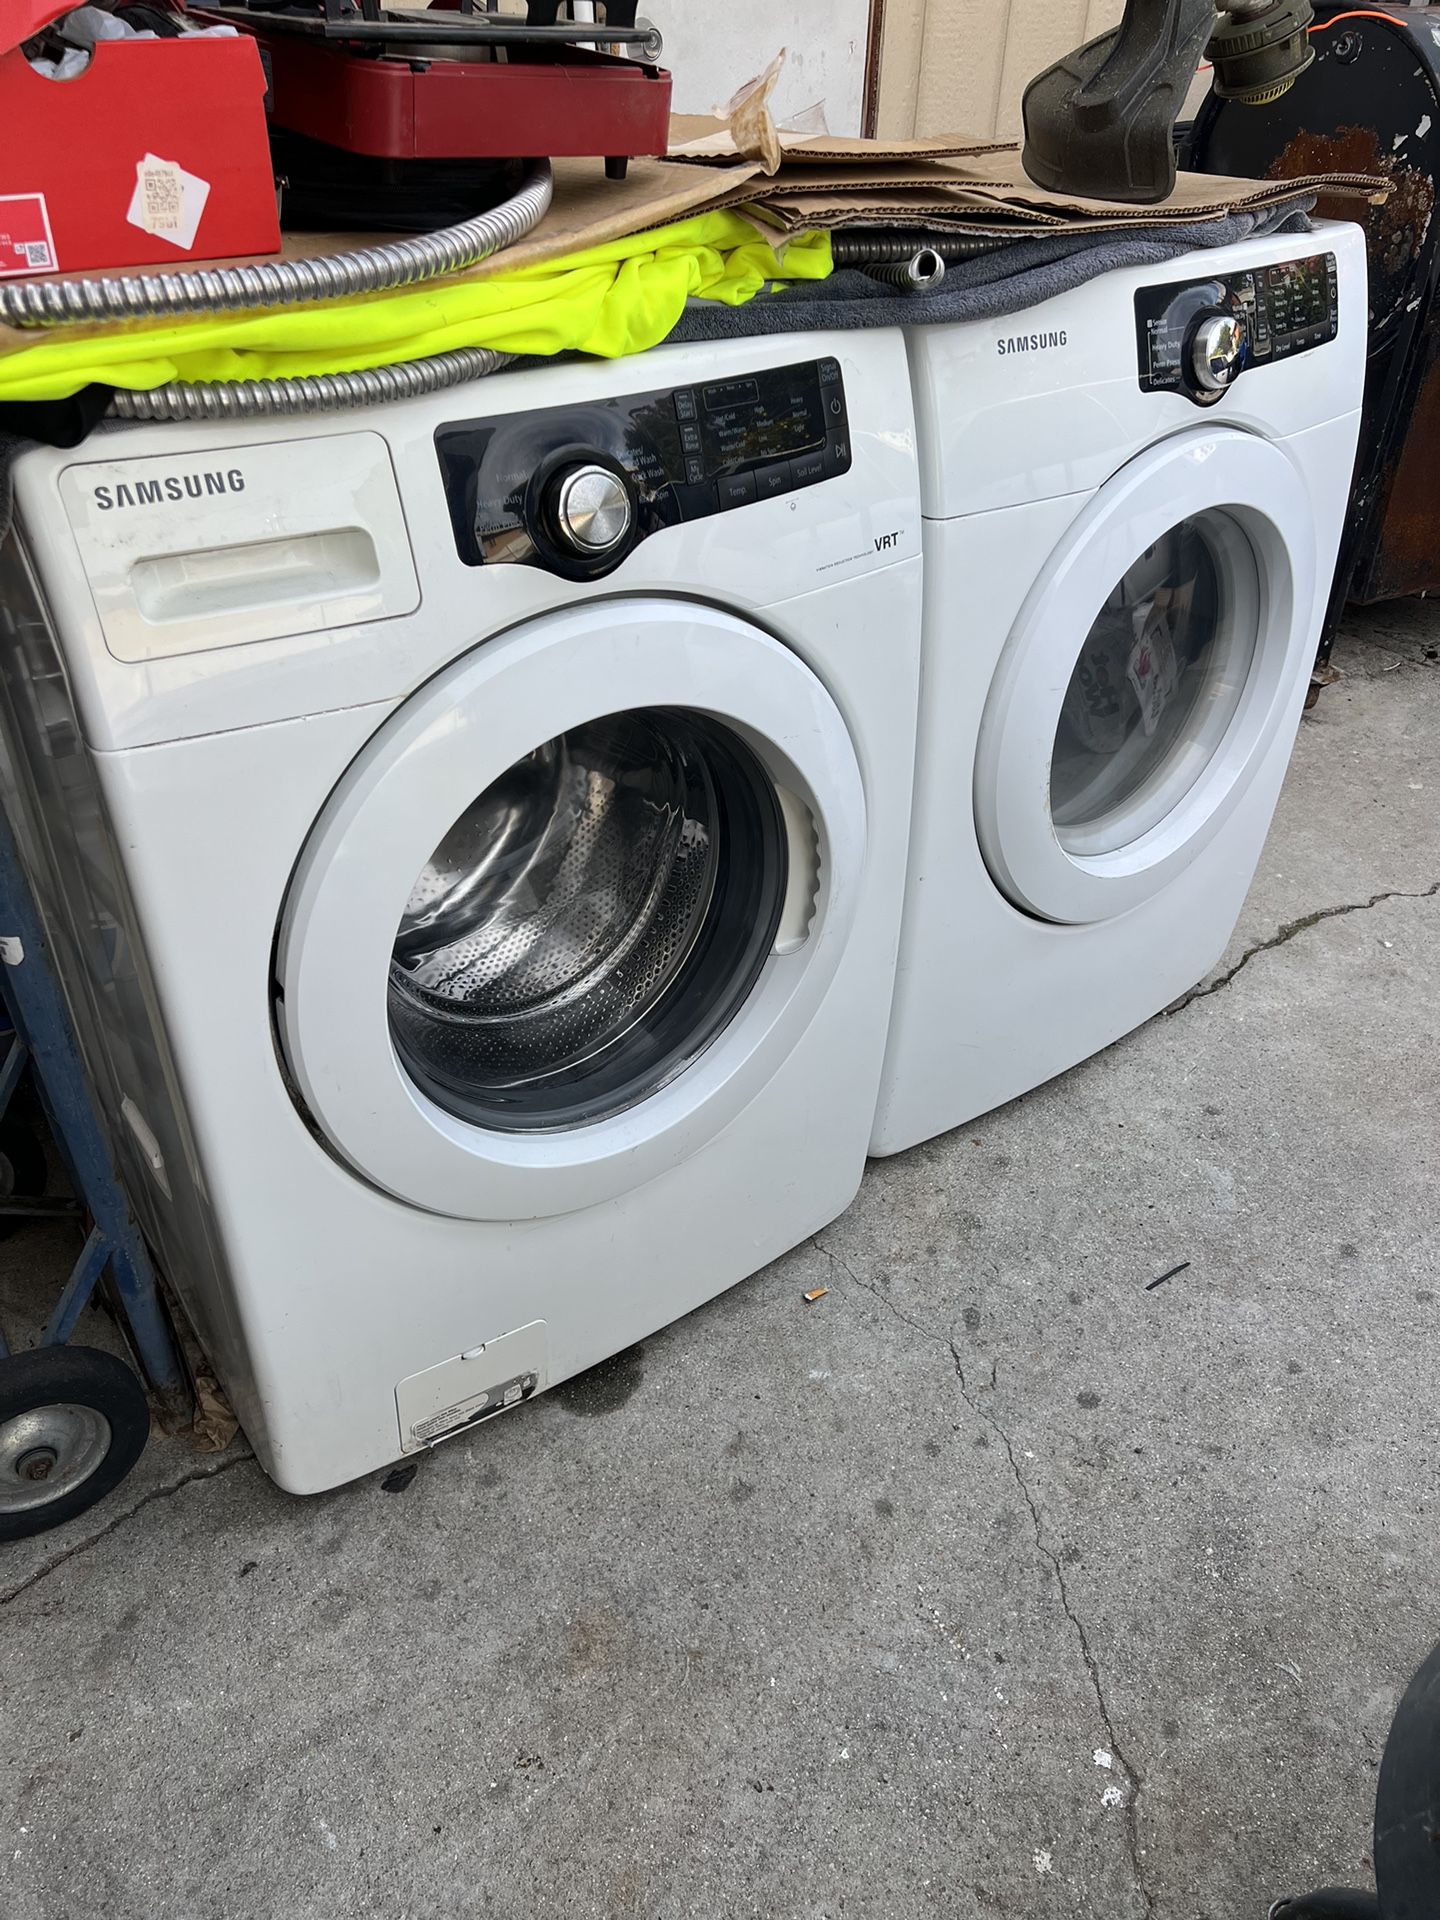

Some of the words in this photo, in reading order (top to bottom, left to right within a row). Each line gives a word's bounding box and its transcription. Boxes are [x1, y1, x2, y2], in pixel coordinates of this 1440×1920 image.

[997, 330, 1067, 355] SAMSUNG
[1167, 340, 1181, 349] Duty
[1153, 376, 1175, 386] Delicates
[678, 401, 692, 411] Delay
[680, 410, 693, 419] Start
[647, 466, 664, 478] Wash
[690, 465, 700, 476] My
[797, 467, 808, 478] Soil
[808, 463, 822, 475] Level
[689, 473, 704, 484] Cycle
[768, 476, 782, 488] Spin
[94, 469, 245, 511] SAMSUNG
[503, 495, 523, 505] Duty
